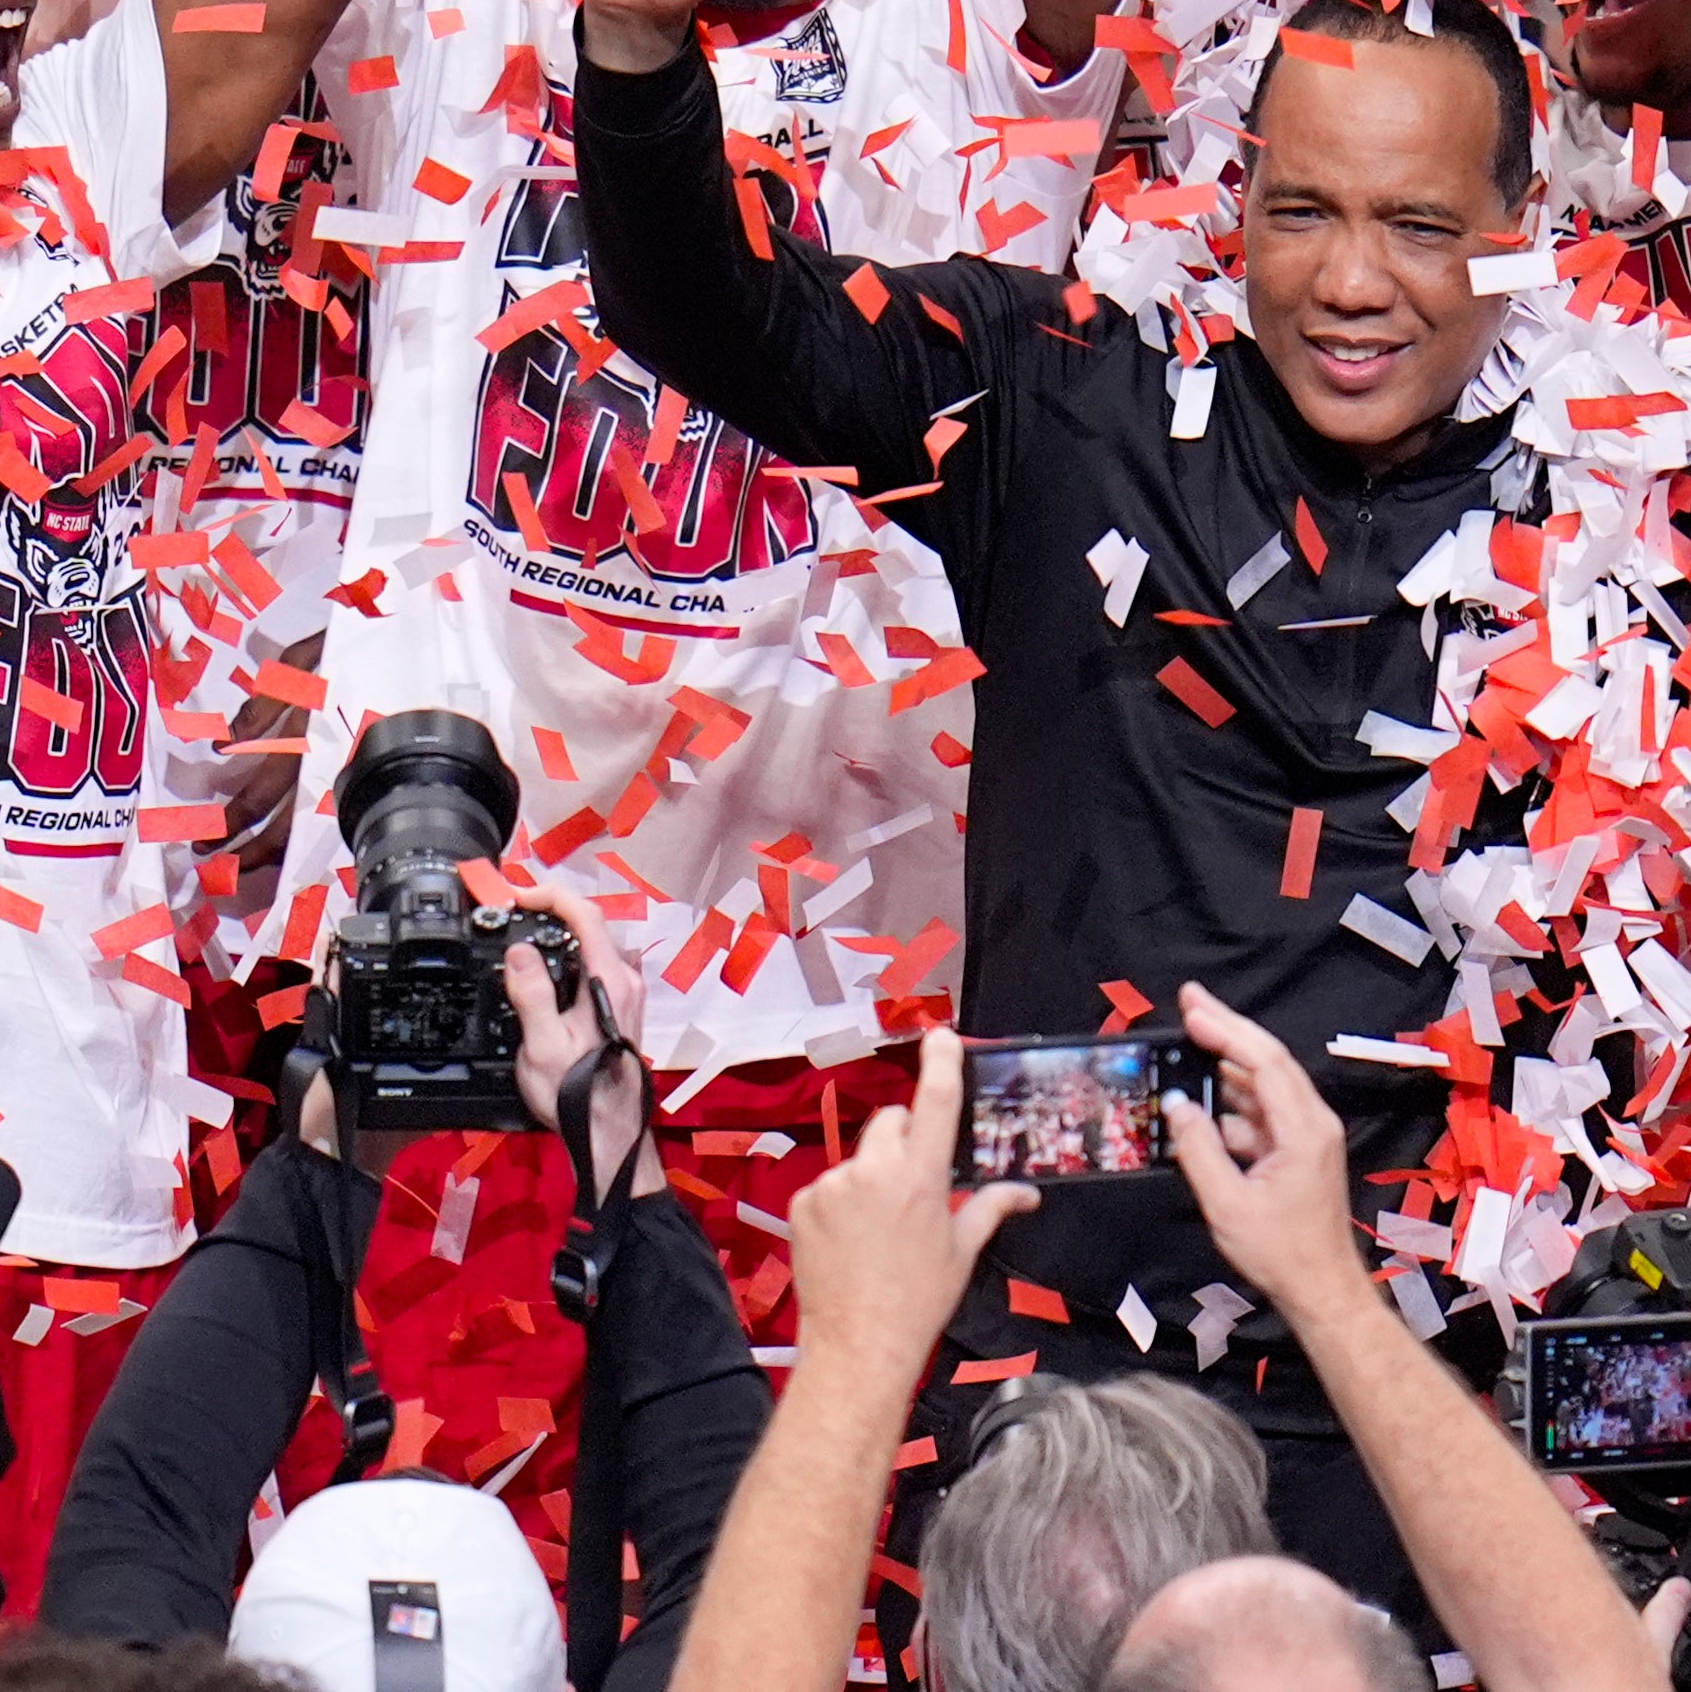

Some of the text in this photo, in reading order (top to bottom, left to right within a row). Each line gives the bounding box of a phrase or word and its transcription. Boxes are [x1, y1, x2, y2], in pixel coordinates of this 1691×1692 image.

[147, 454, 292, 478] REONAL
[463, 518, 520, 575] SOUTH
[520, 558, 662, 609] REGIONAL
[5, 804, 114, 831] REGIONAL
